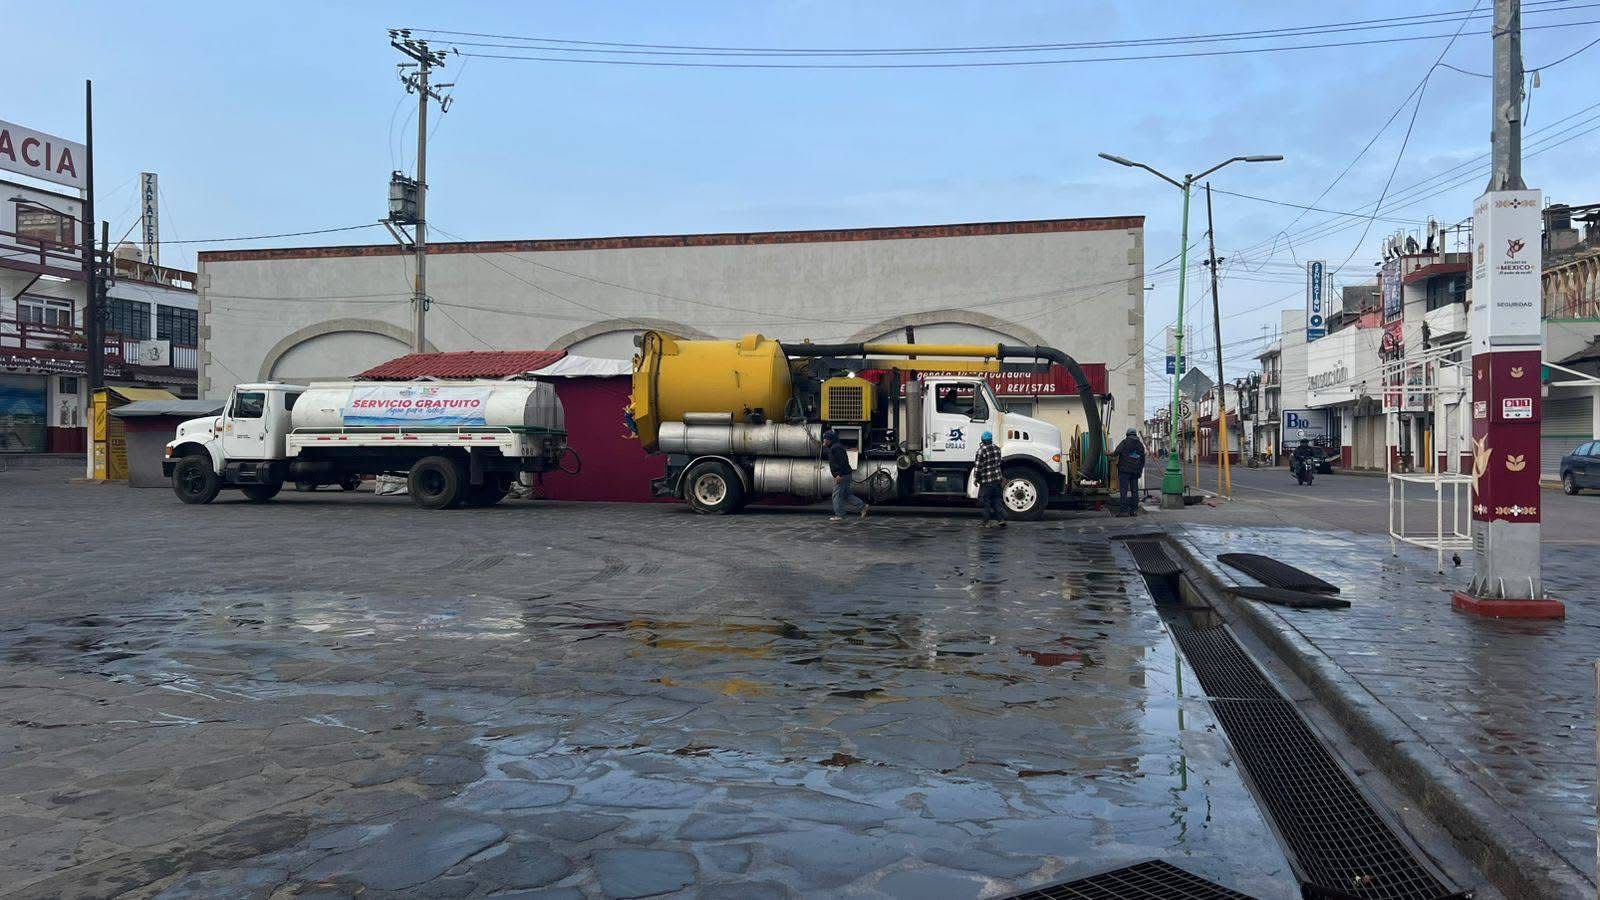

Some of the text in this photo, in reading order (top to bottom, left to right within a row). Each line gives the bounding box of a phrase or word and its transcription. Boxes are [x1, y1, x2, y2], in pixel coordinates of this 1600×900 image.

[146, 174, 154, 265] ZAPATERIA
[1007, 383, 1056, 392] REVISTAS
[353, 399, 480, 408] SERVICIO GRATUITO
